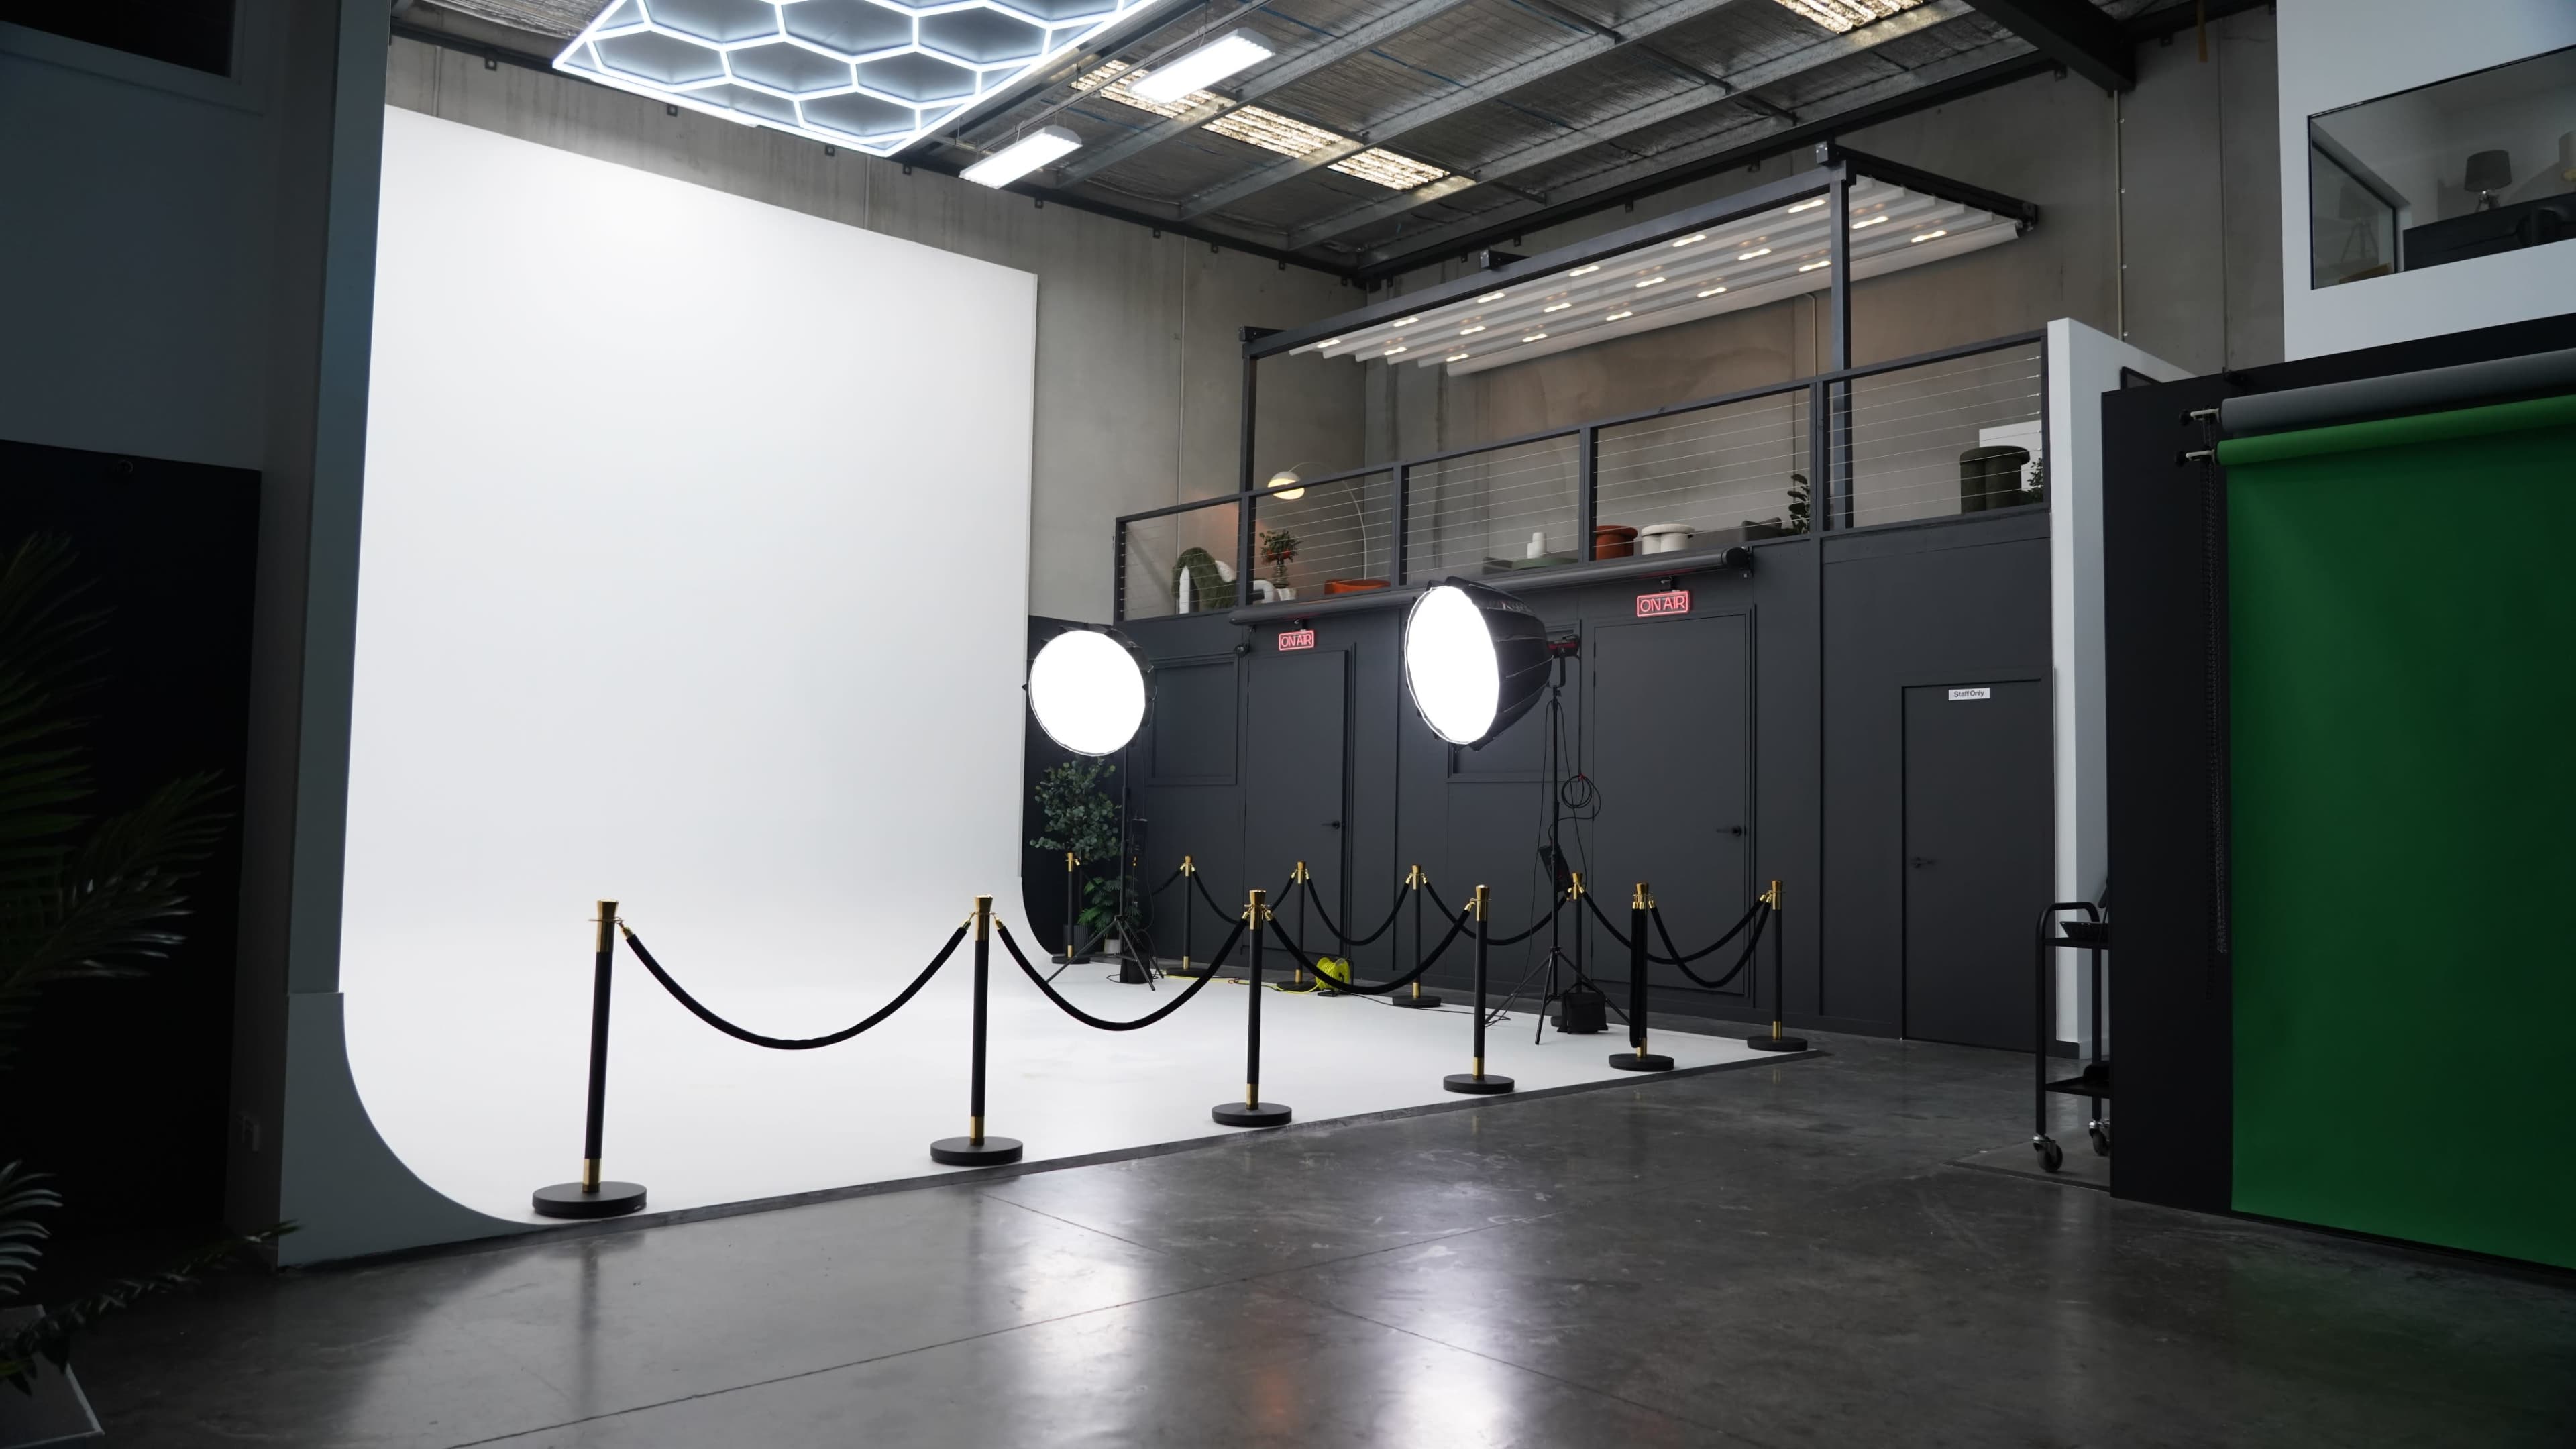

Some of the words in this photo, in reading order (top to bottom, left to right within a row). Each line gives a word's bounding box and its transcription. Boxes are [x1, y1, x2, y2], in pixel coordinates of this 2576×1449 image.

[1640, 598, 1661, 612] ON
[1663, 595, 1686, 610] AIR
[1281, 636, 1295, 647] ON
[1297, 633, 1311, 646] AIR
